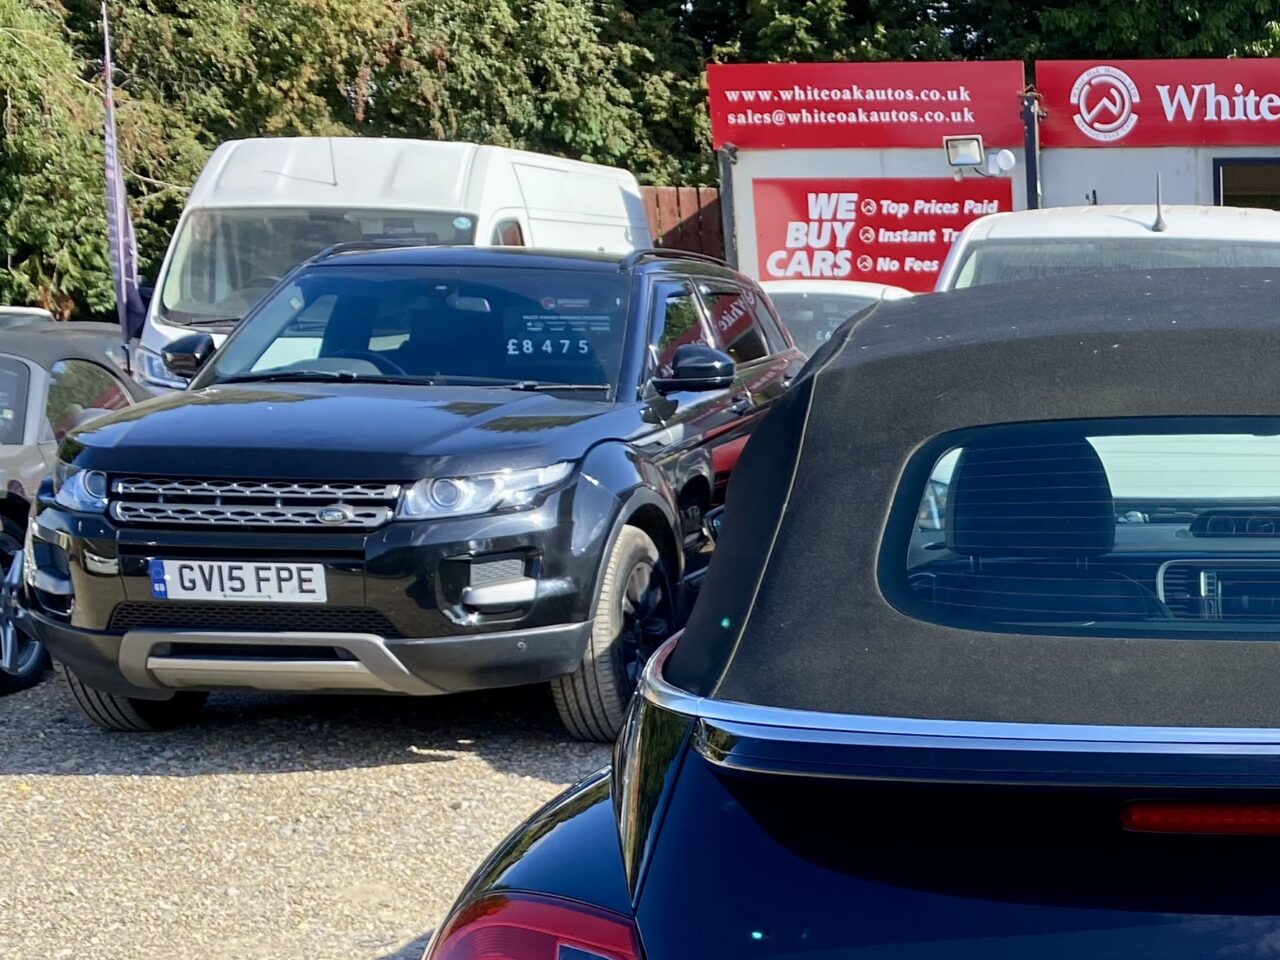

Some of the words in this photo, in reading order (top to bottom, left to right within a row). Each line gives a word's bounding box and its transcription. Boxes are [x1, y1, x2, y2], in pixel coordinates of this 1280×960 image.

[724, 85, 972, 102] www.whiteoakautos.co.uk
[728, 107, 976, 126] sales@whiteoakautos.co.uk
[807, 193, 859, 220] WE
[880, 200, 909, 218] Top
[913, 199, 959, 215] Prices
[963, 199, 999, 215] Paid
[785, 221, 854, 248] BUY
[878, 228, 937, 242] Instant
[766, 250, 852, 277] CARS
[876, 256, 900, 271] No
[904, 256, 939, 271] Fees
[506, 338, 589, 355] £8475
[178, 563, 246, 593] GV15
[254, 565, 317, 594] FPE
